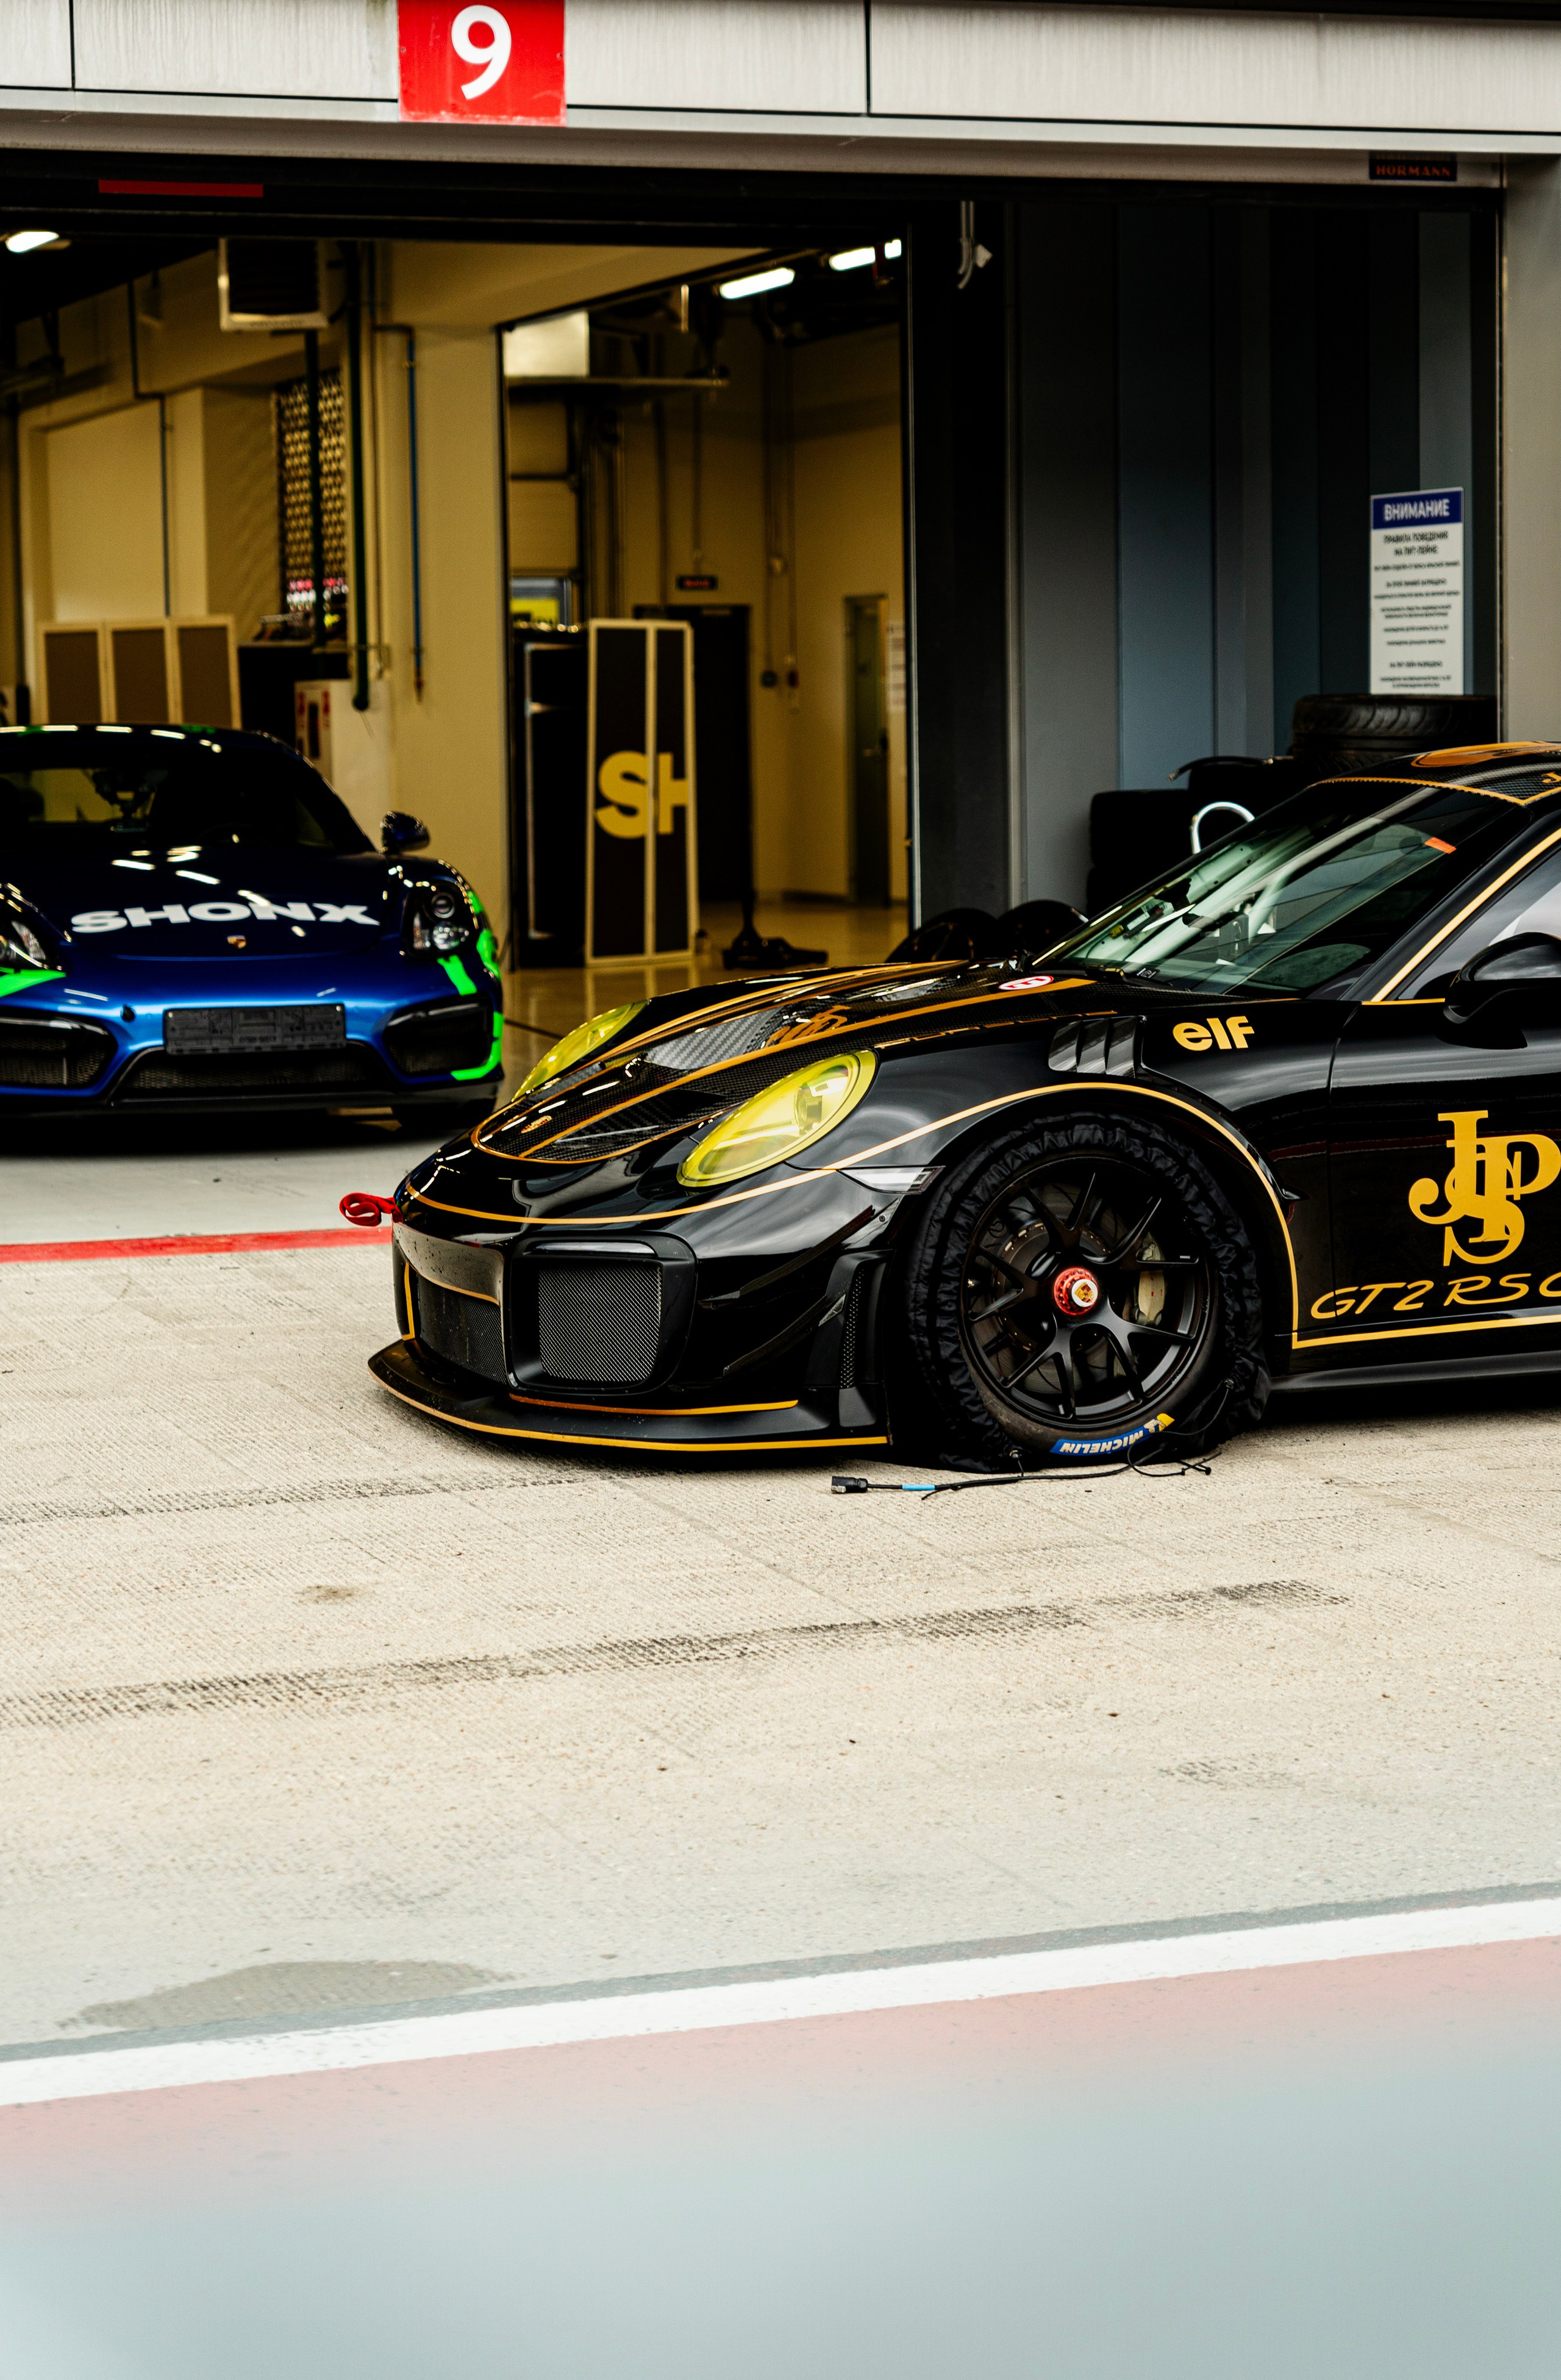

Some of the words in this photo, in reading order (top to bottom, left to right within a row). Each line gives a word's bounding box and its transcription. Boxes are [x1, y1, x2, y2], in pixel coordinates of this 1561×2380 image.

[451, 5, 512, 99] 9
[1384, 498, 1450, 522] ВНИМАНИЕ
[71, 902, 380, 933] SHONX
[1173, 1016, 1255, 1051] elf
[1443, 1274, 1532, 1306] RS
[1059, 1430, 1143, 1453] MICHELIN
